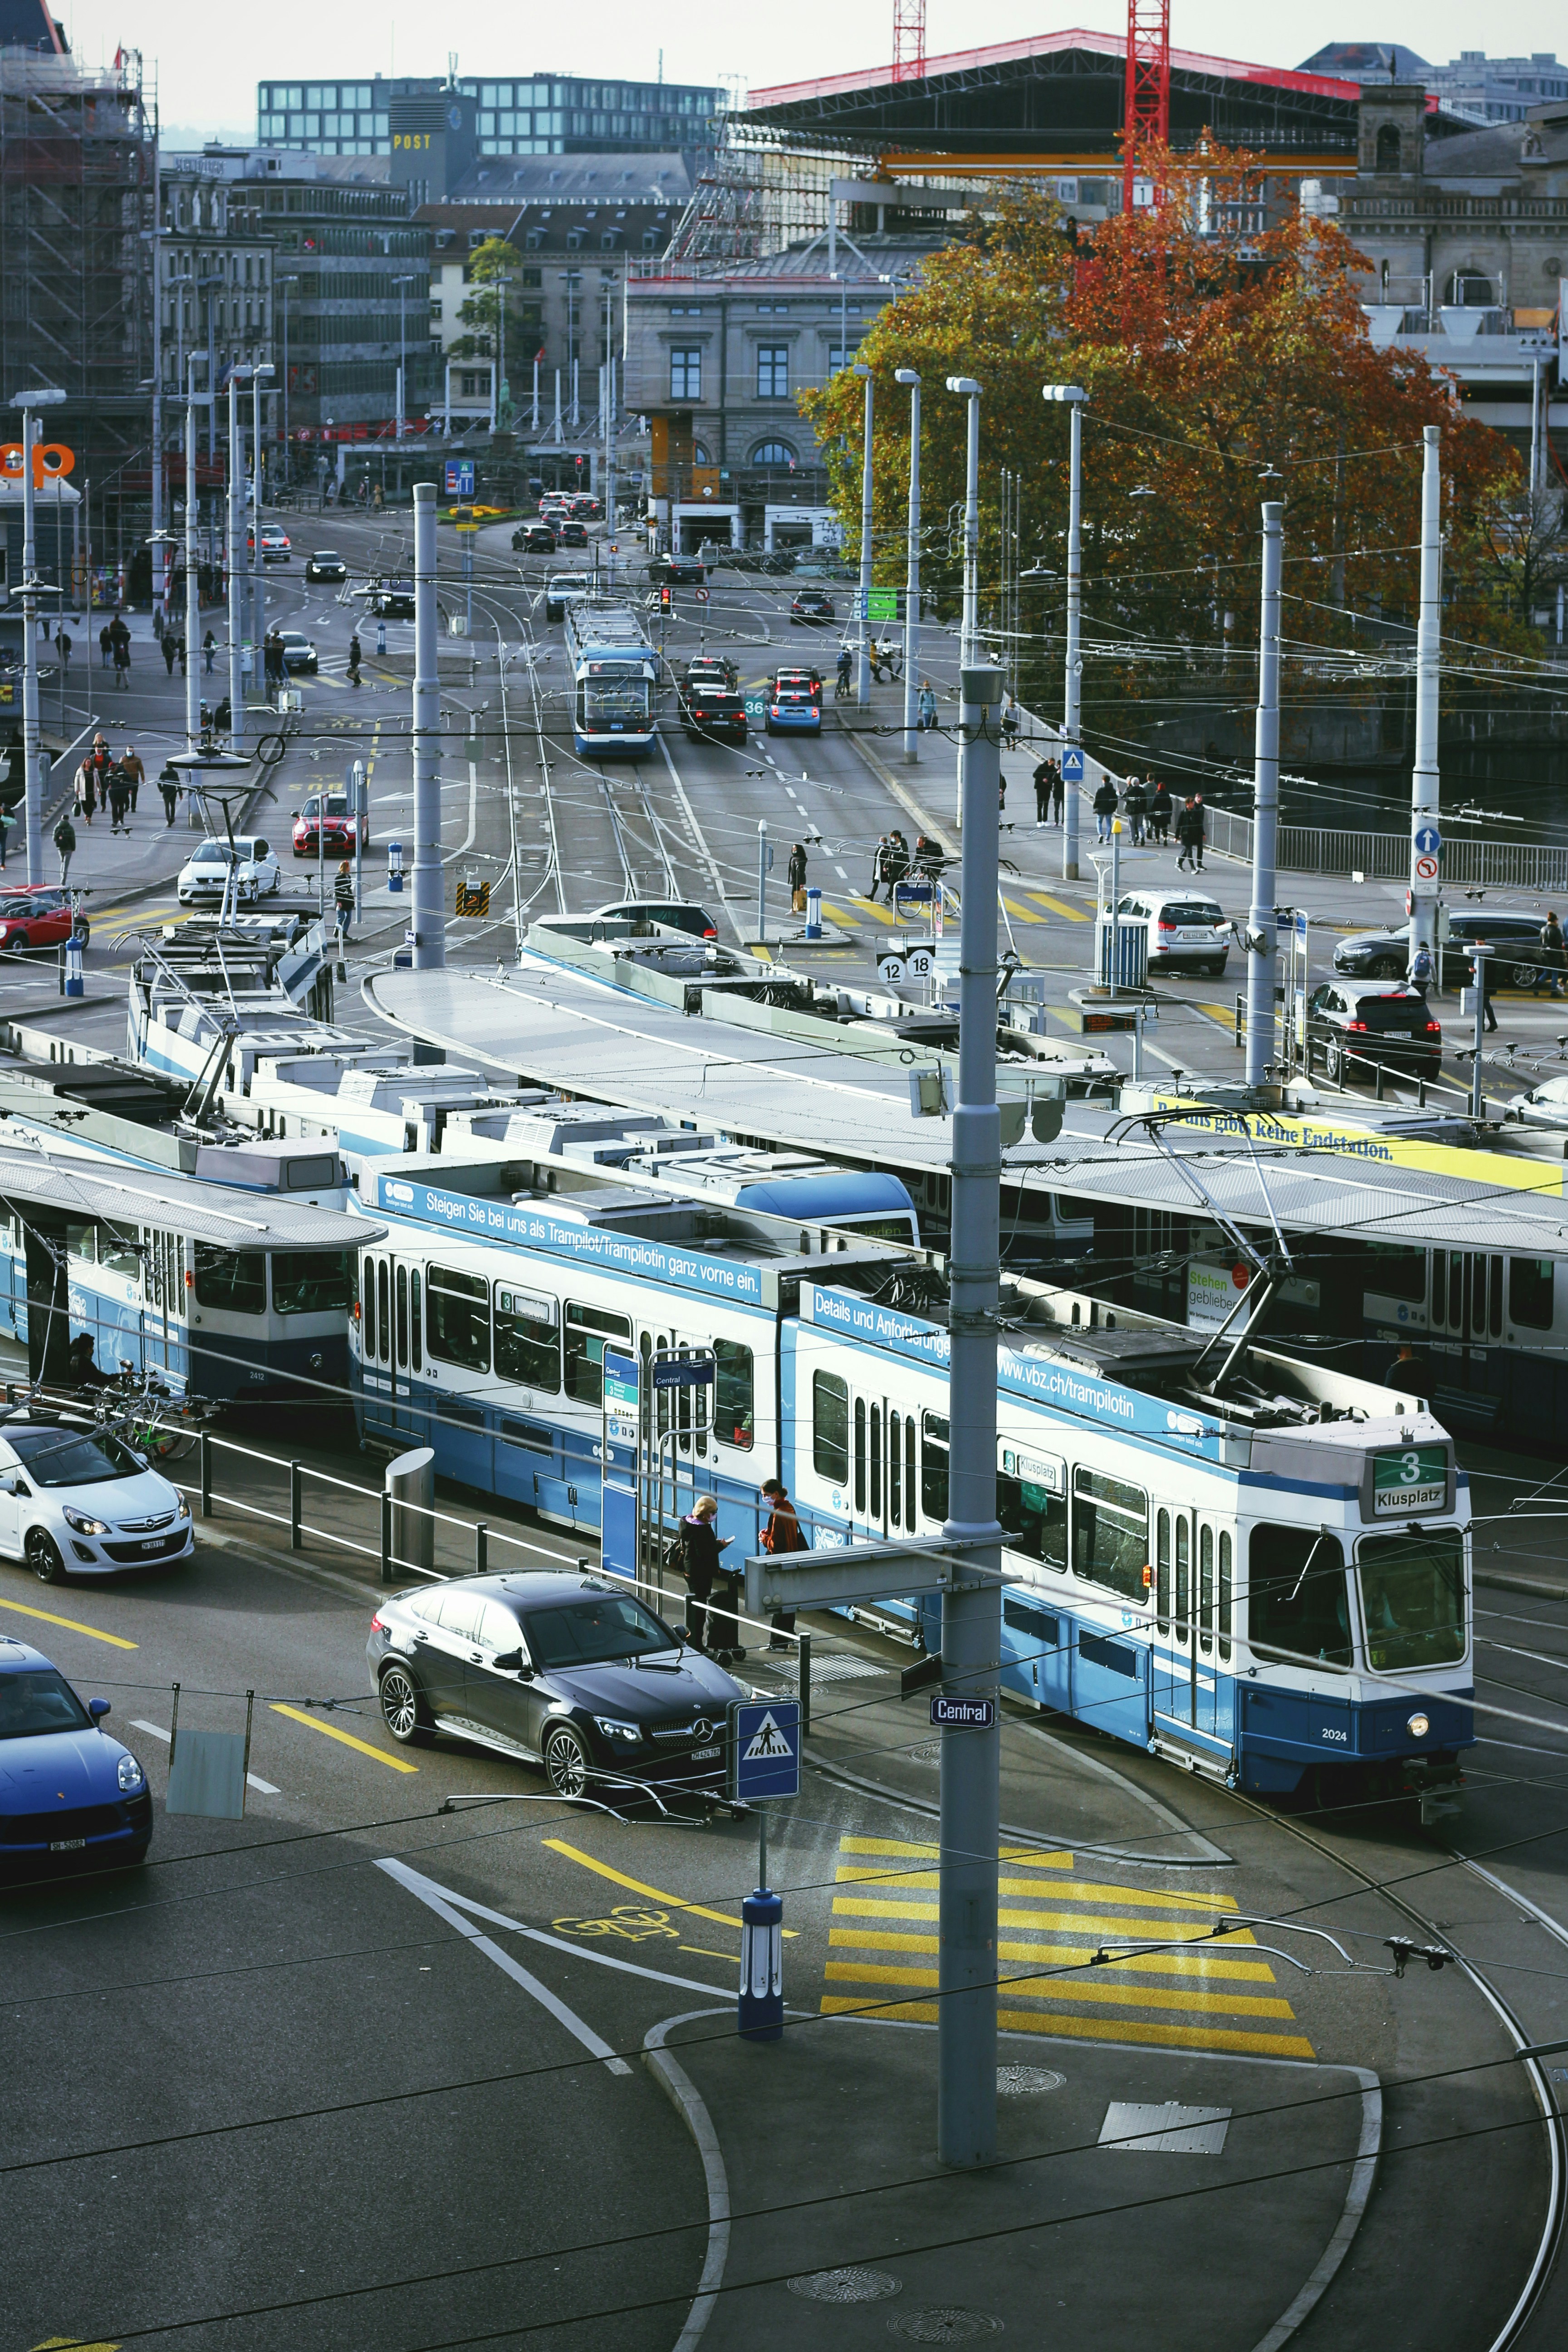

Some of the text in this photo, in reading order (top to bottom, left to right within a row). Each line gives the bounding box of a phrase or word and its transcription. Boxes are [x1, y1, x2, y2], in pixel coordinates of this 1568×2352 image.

[394, 134, 431, 150] POST
[1140, 187, 1145, 203] 1
[745, 701, 764, 714] 36
[884, 964, 900, 979] 12
[913, 957, 929, 972] 18
[1256, 1119, 1298, 1143] keine
[426, 1191, 466, 1220] Steigen
[468, 1202, 486, 1224] Sie
[488, 1207, 505, 1229] bei
[507, 1216, 527, 1234] uns
[529, 1220, 545, 1239] als
[548, 1222, 666, 1269] Trampilot/Trampilotin
[668, 1257, 697, 1277] ganz
[700, 1264, 735, 1287] vorne
[737, 1270, 759, 1293] ein.
[1190, 1271, 1227, 1291] Stehen
[505, 1295, 510, 1309] 3
[815, 1292, 851, 1322] Details
[853, 1309, 873, 1330] und
[250, 1371, 265, 1381] 2412
[656, 1376, 681, 1384] Central
[609, 1385, 614, 1395] 3
[1007, 1454, 1054, 1480] 3 Klusplatz
[1400, 1452, 1421, 1483] 3
[1377, 1489, 1441, 1507] Klusplatz
[938, 1700, 986, 1721] Central
[1322, 1728, 1348, 1742] 2024
